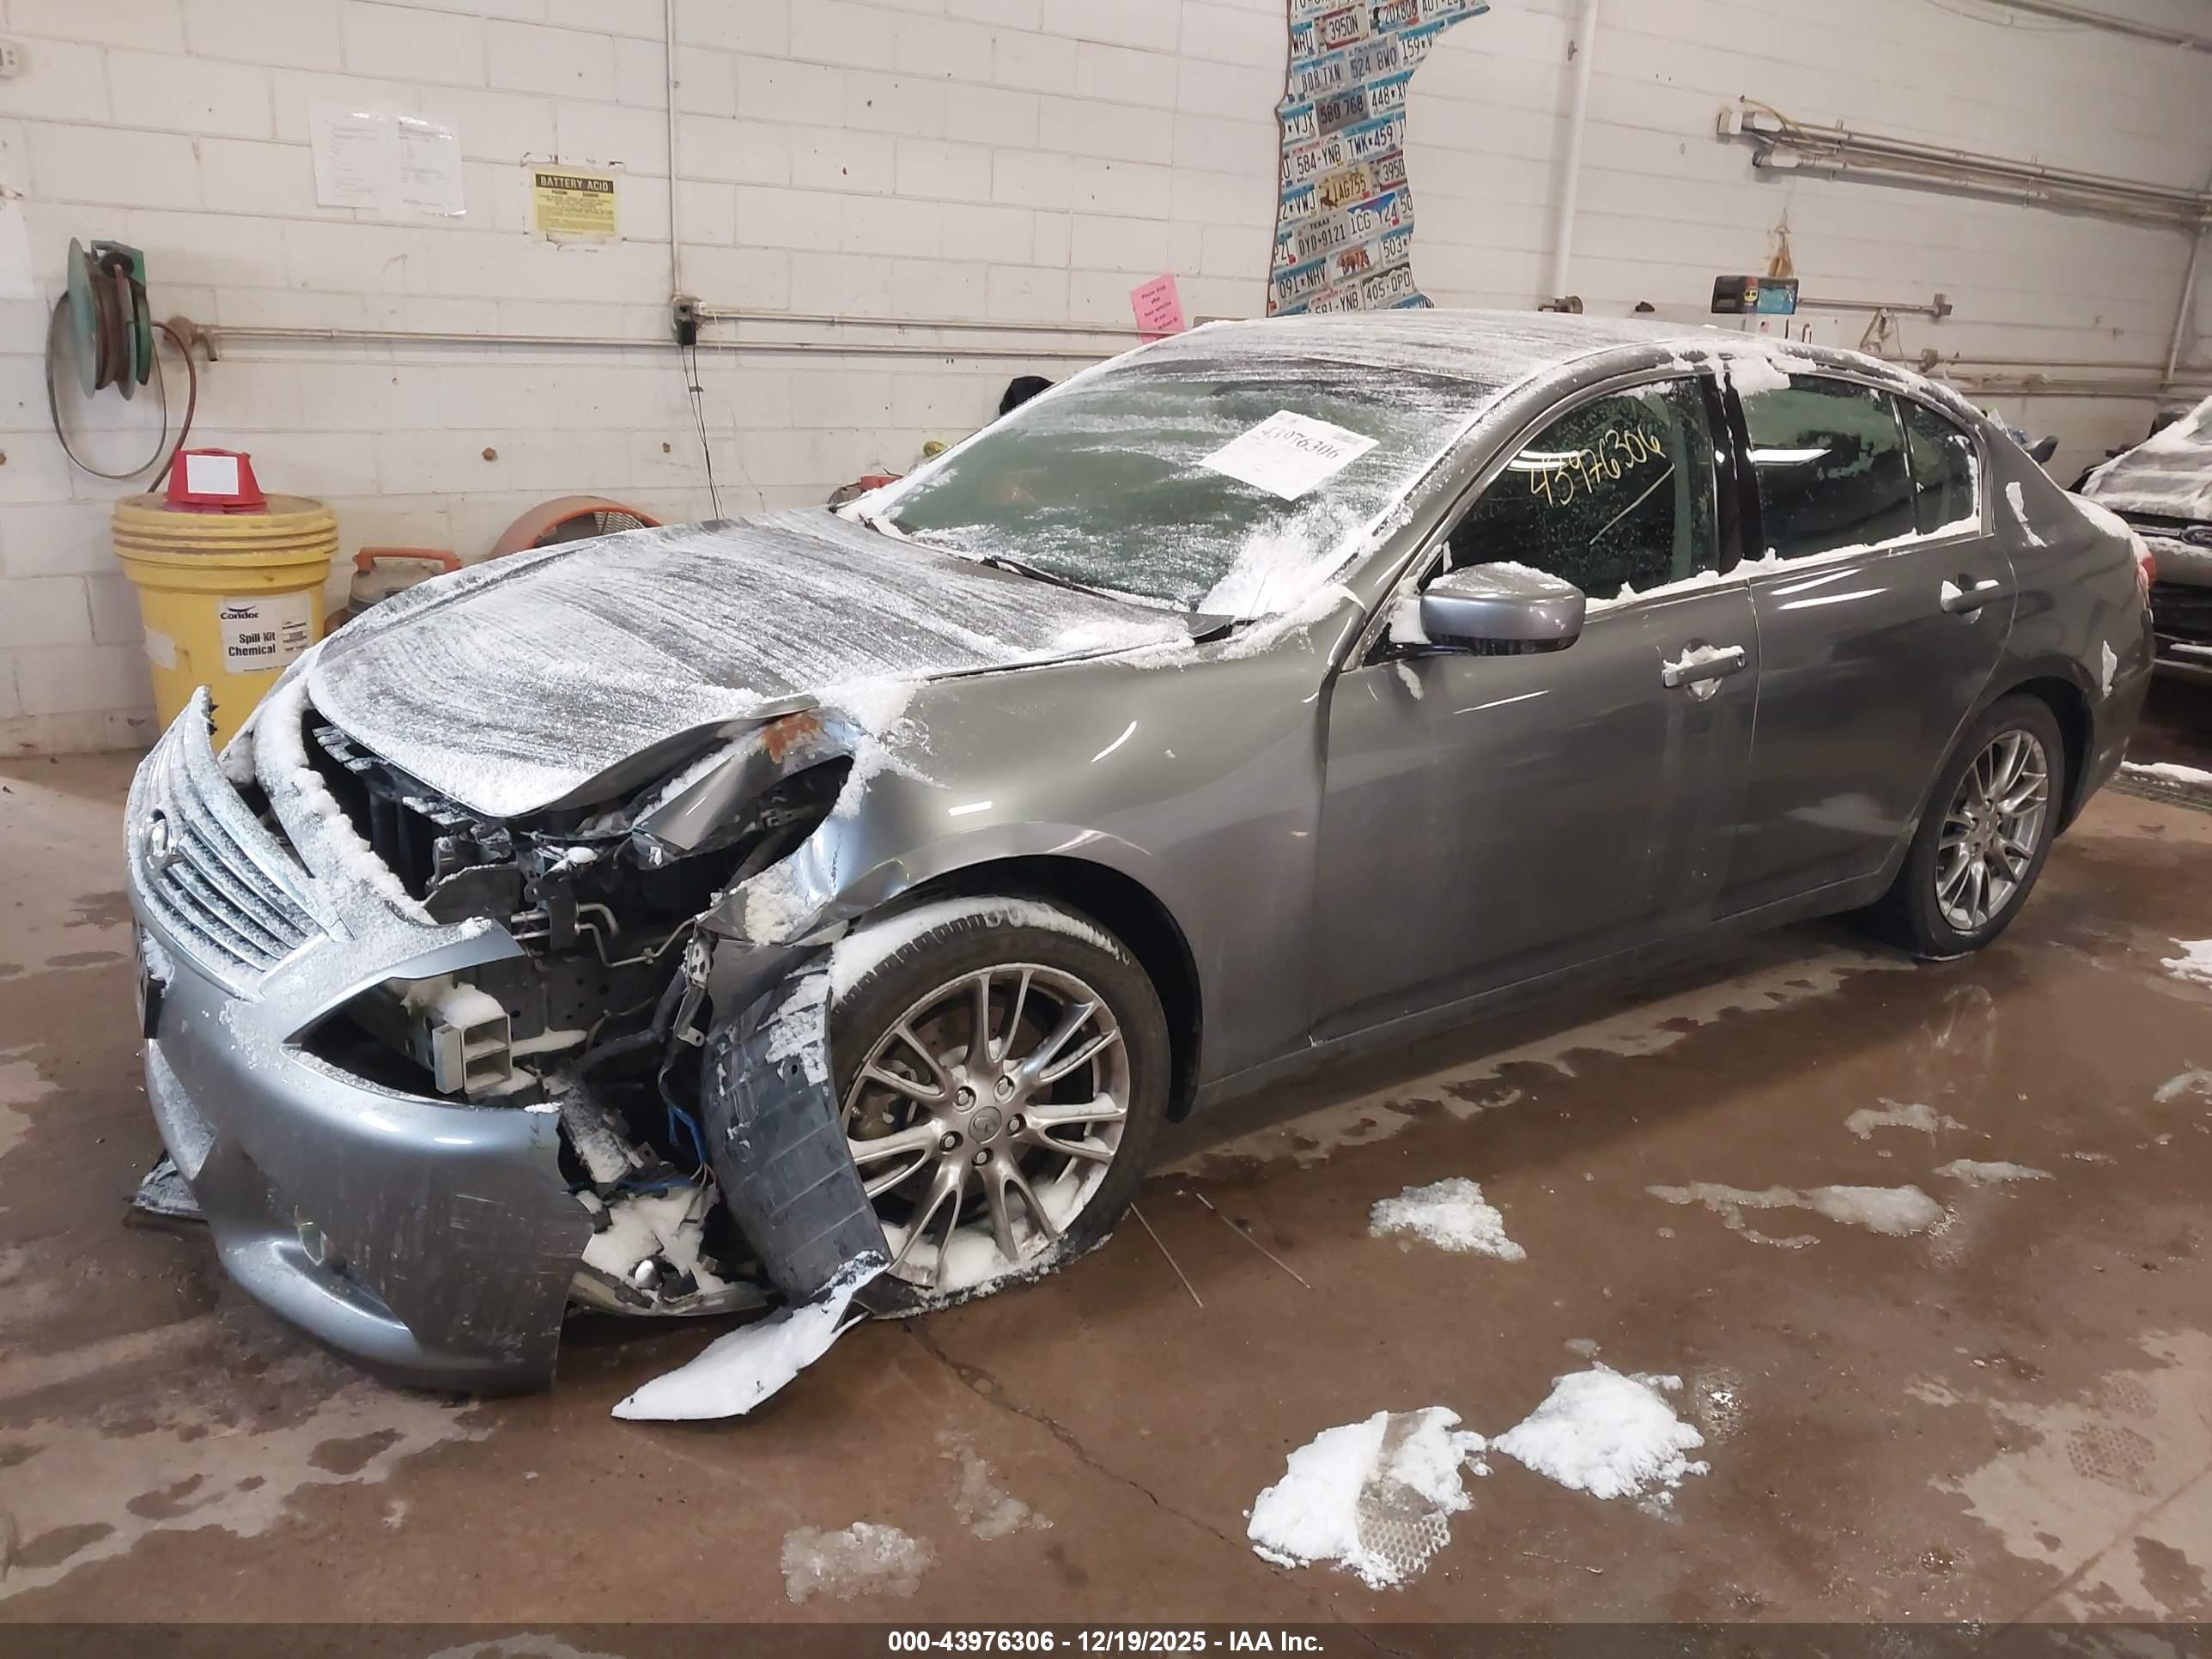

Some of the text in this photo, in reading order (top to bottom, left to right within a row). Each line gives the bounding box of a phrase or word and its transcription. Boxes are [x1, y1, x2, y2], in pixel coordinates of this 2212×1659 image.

[540, 175, 609, 192] BATTERY ACID
[1310, 217, 1330, 231] TEXAS
[220, 611, 260, 620] Condor
[239, 631, 276, 645] Spill Kit
[228, 644, 276, 656] Chemical
